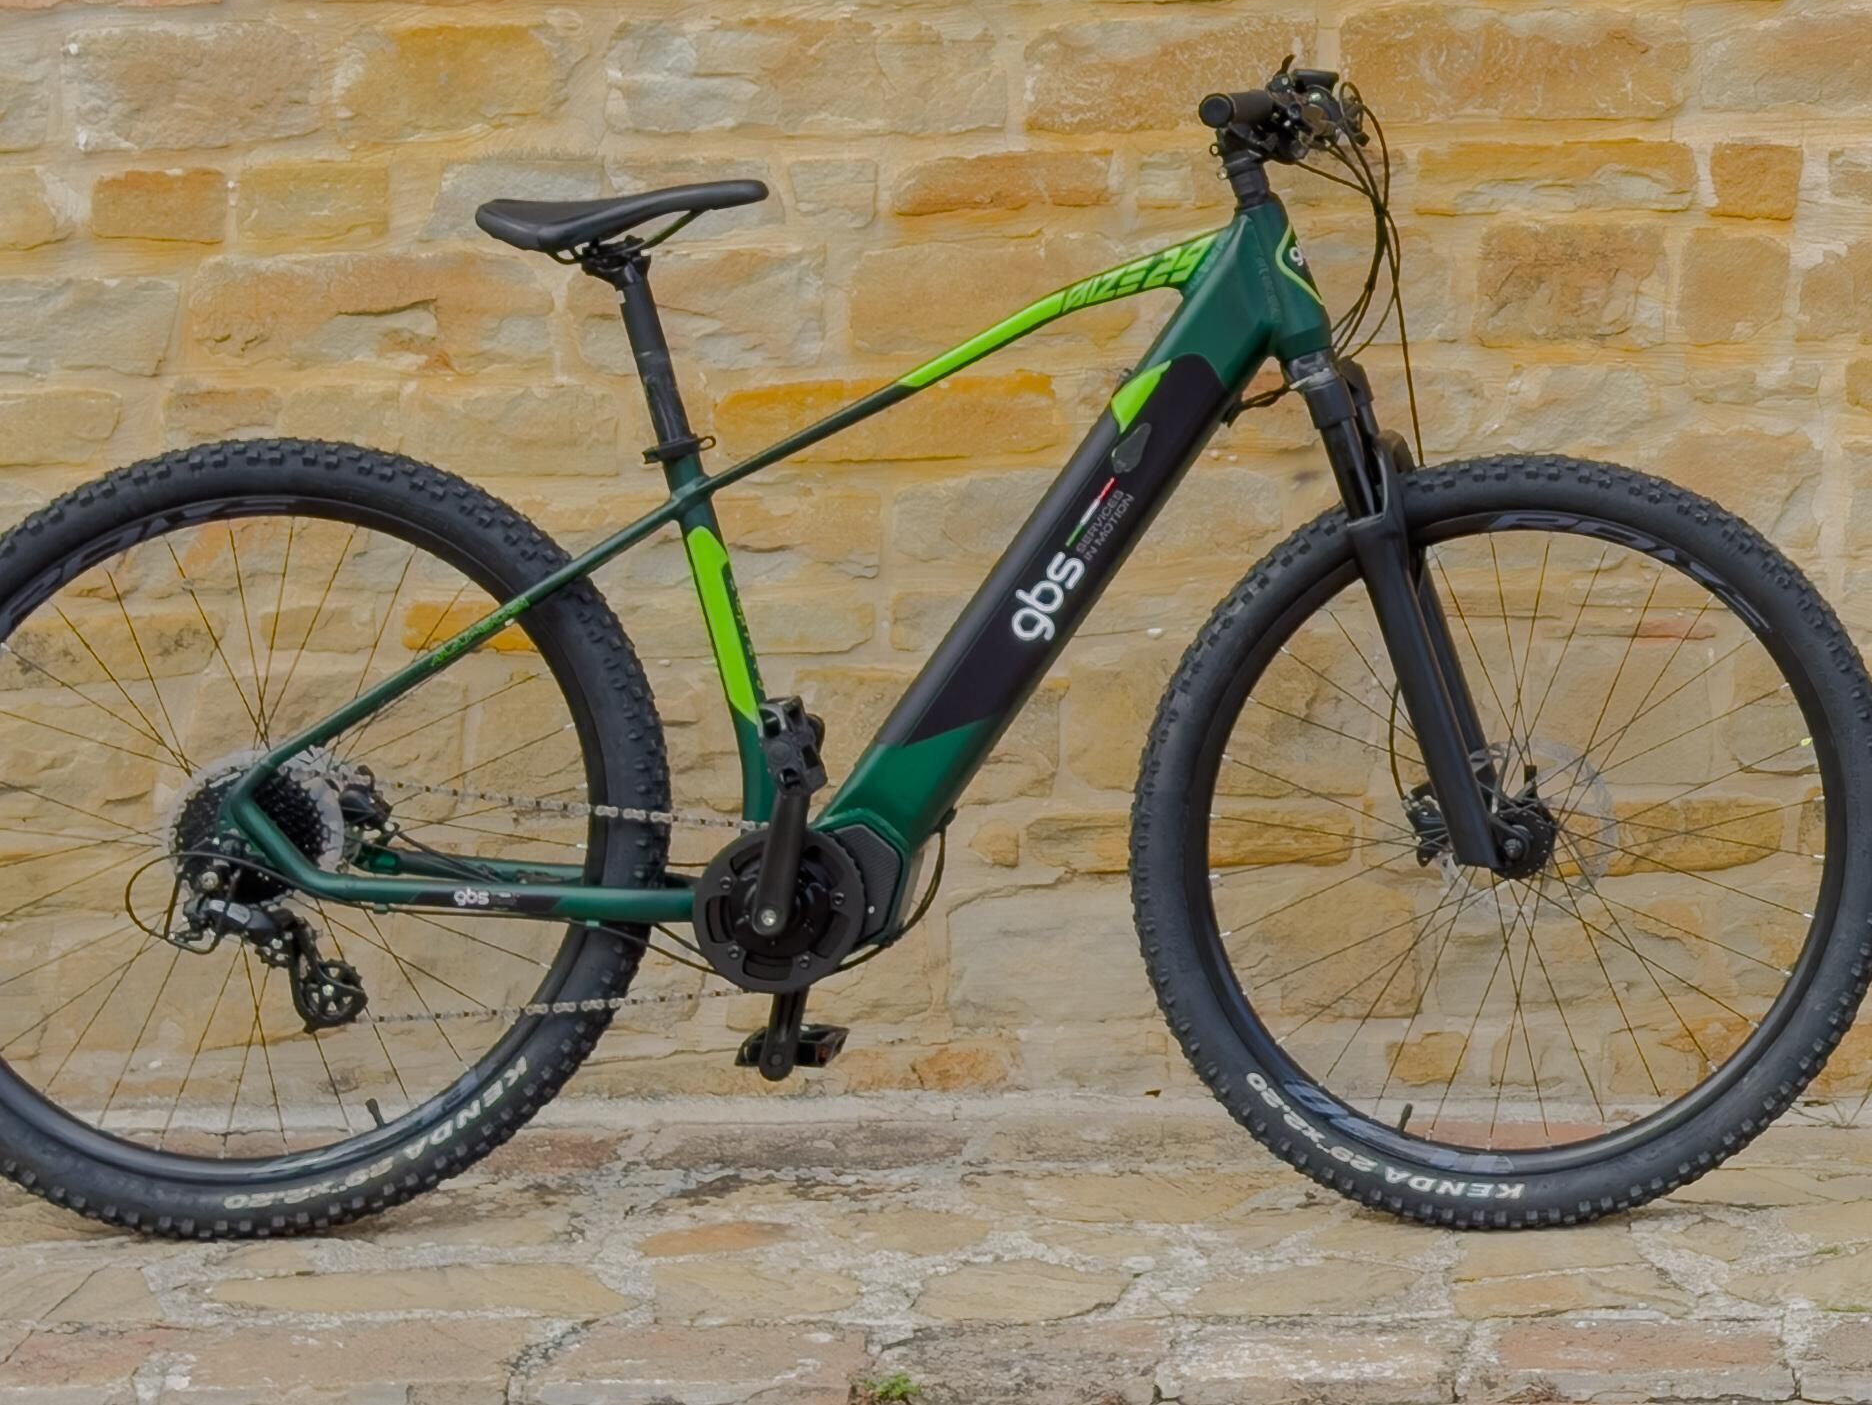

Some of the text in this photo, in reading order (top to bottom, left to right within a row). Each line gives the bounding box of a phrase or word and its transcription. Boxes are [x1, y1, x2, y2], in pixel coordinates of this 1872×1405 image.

[1076, 489, 1124, 553] SERVICES
[1084, 493, 1135, 561] IN MOTION
[1011, 551, 1086, 641] gbs
[453, 886, 490, 906] gbs
[402, 1055, 529, 1162] KENDA
[1382, 1165, 1526, 1199] KENDA
